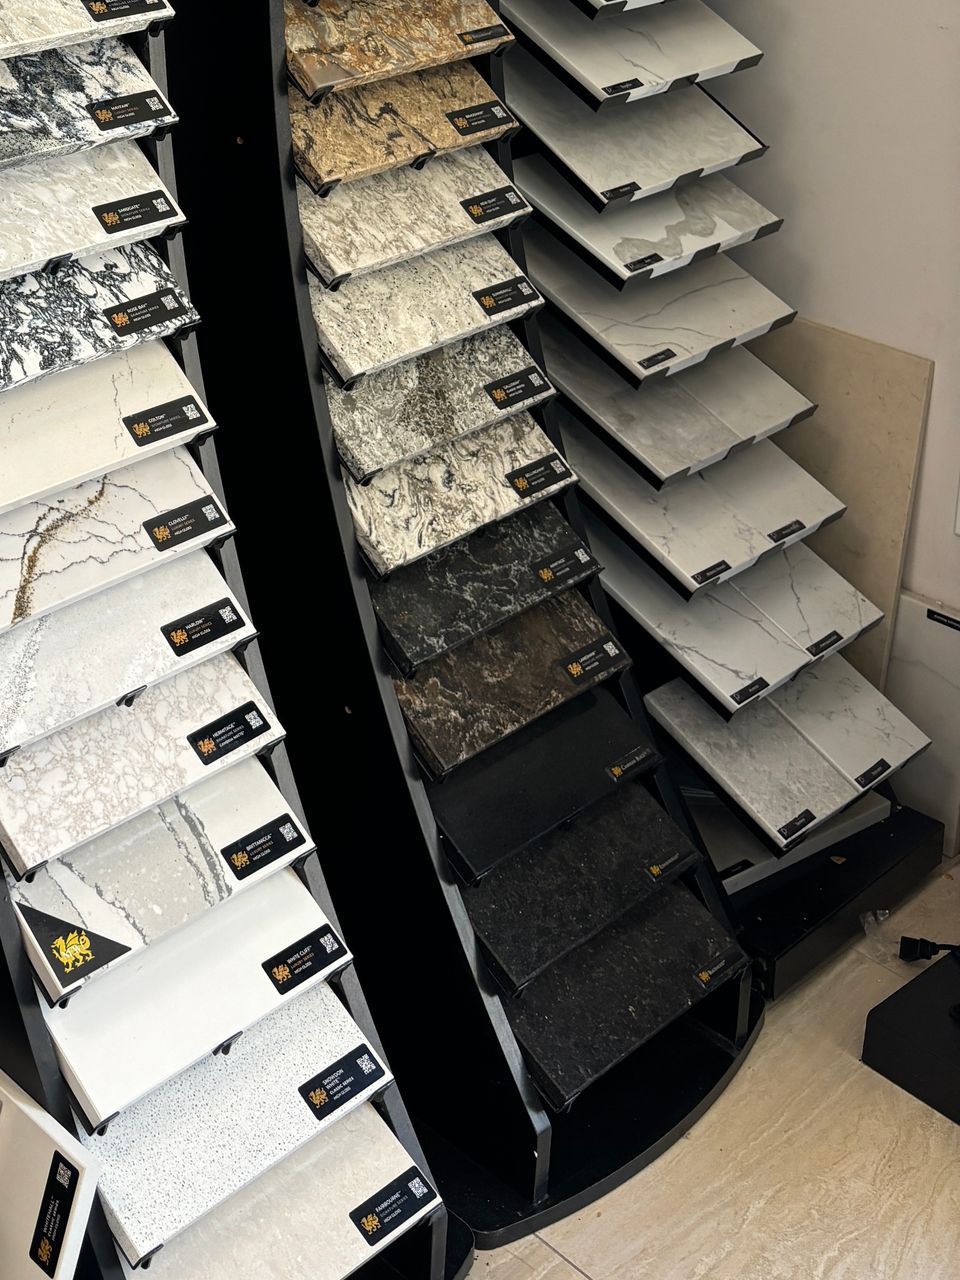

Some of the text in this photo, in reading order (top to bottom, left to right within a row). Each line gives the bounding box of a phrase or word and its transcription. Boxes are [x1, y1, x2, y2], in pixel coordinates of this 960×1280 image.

[287, 953, 300, 964] WHITE
[322, 1068, 344, 1085] SNOWDON
[330, 1076, 354, 1095] CLASSIC SERIES
[384, 1209, 401, 1223] HIGH GLOSS
